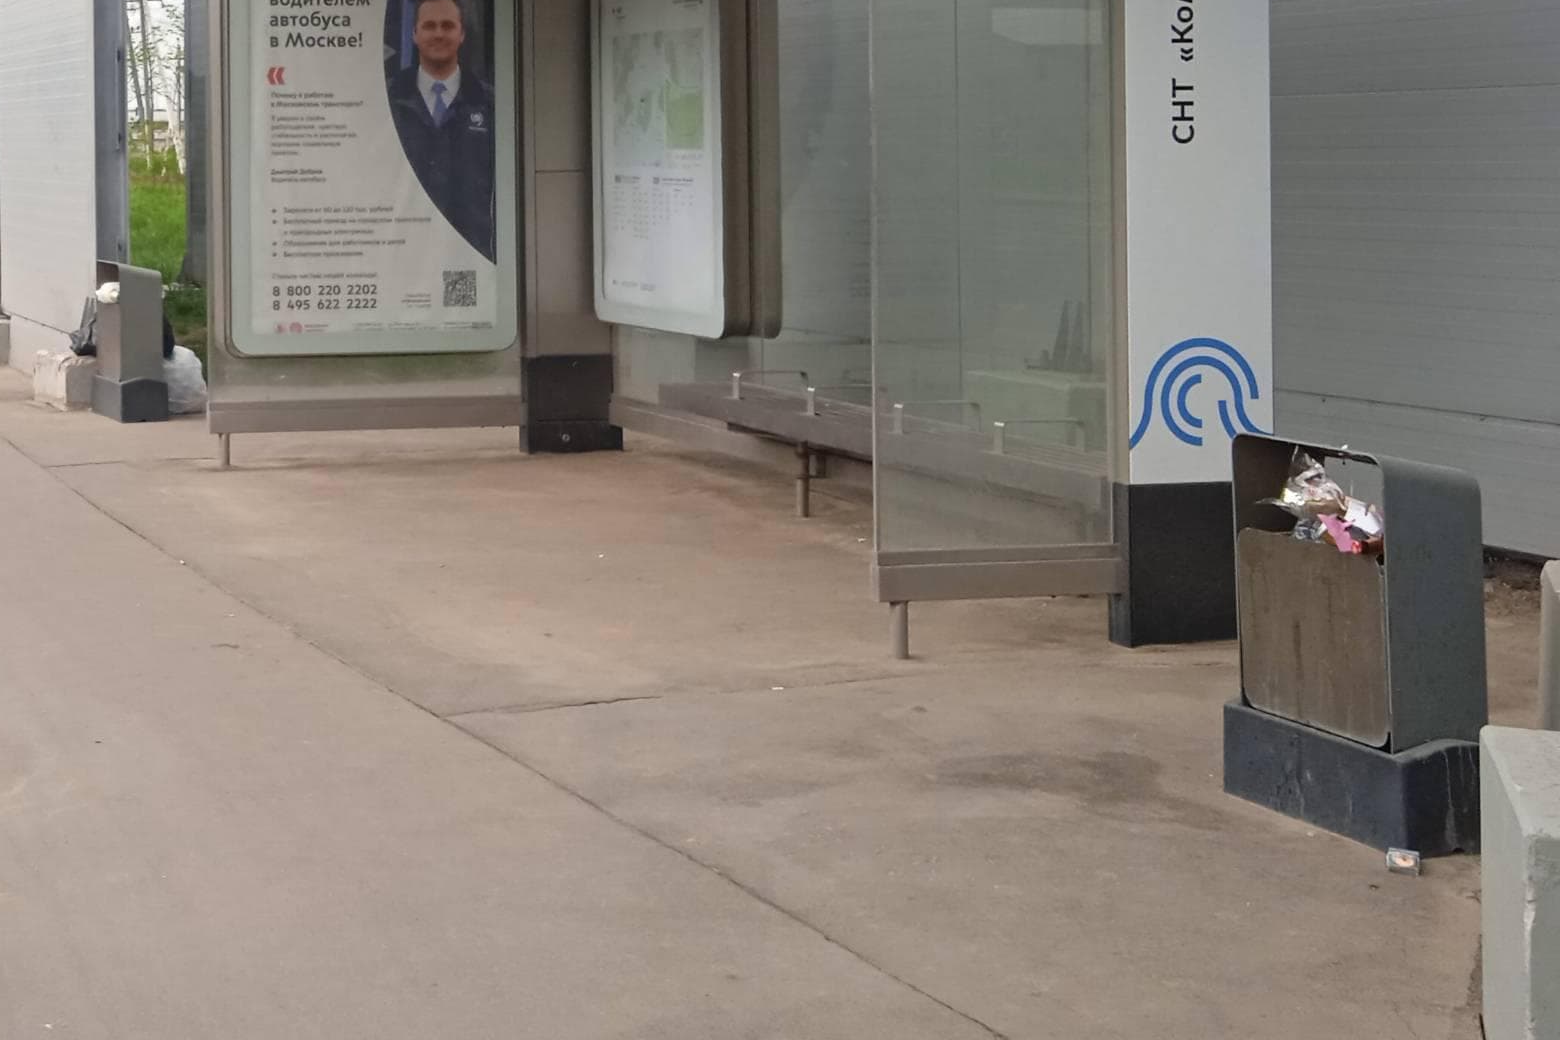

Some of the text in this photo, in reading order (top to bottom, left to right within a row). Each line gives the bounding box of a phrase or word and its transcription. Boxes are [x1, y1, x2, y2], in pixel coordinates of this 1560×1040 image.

[269, 11, 351, 31] автобуса
[270, 32, 363, 48] в Москве!
[1172, 78, 1195, 144] СНТ
[272, 284, 377, 296] 8 800 220 2202
[272, 298, 377, 310] 8 495 622 2222
